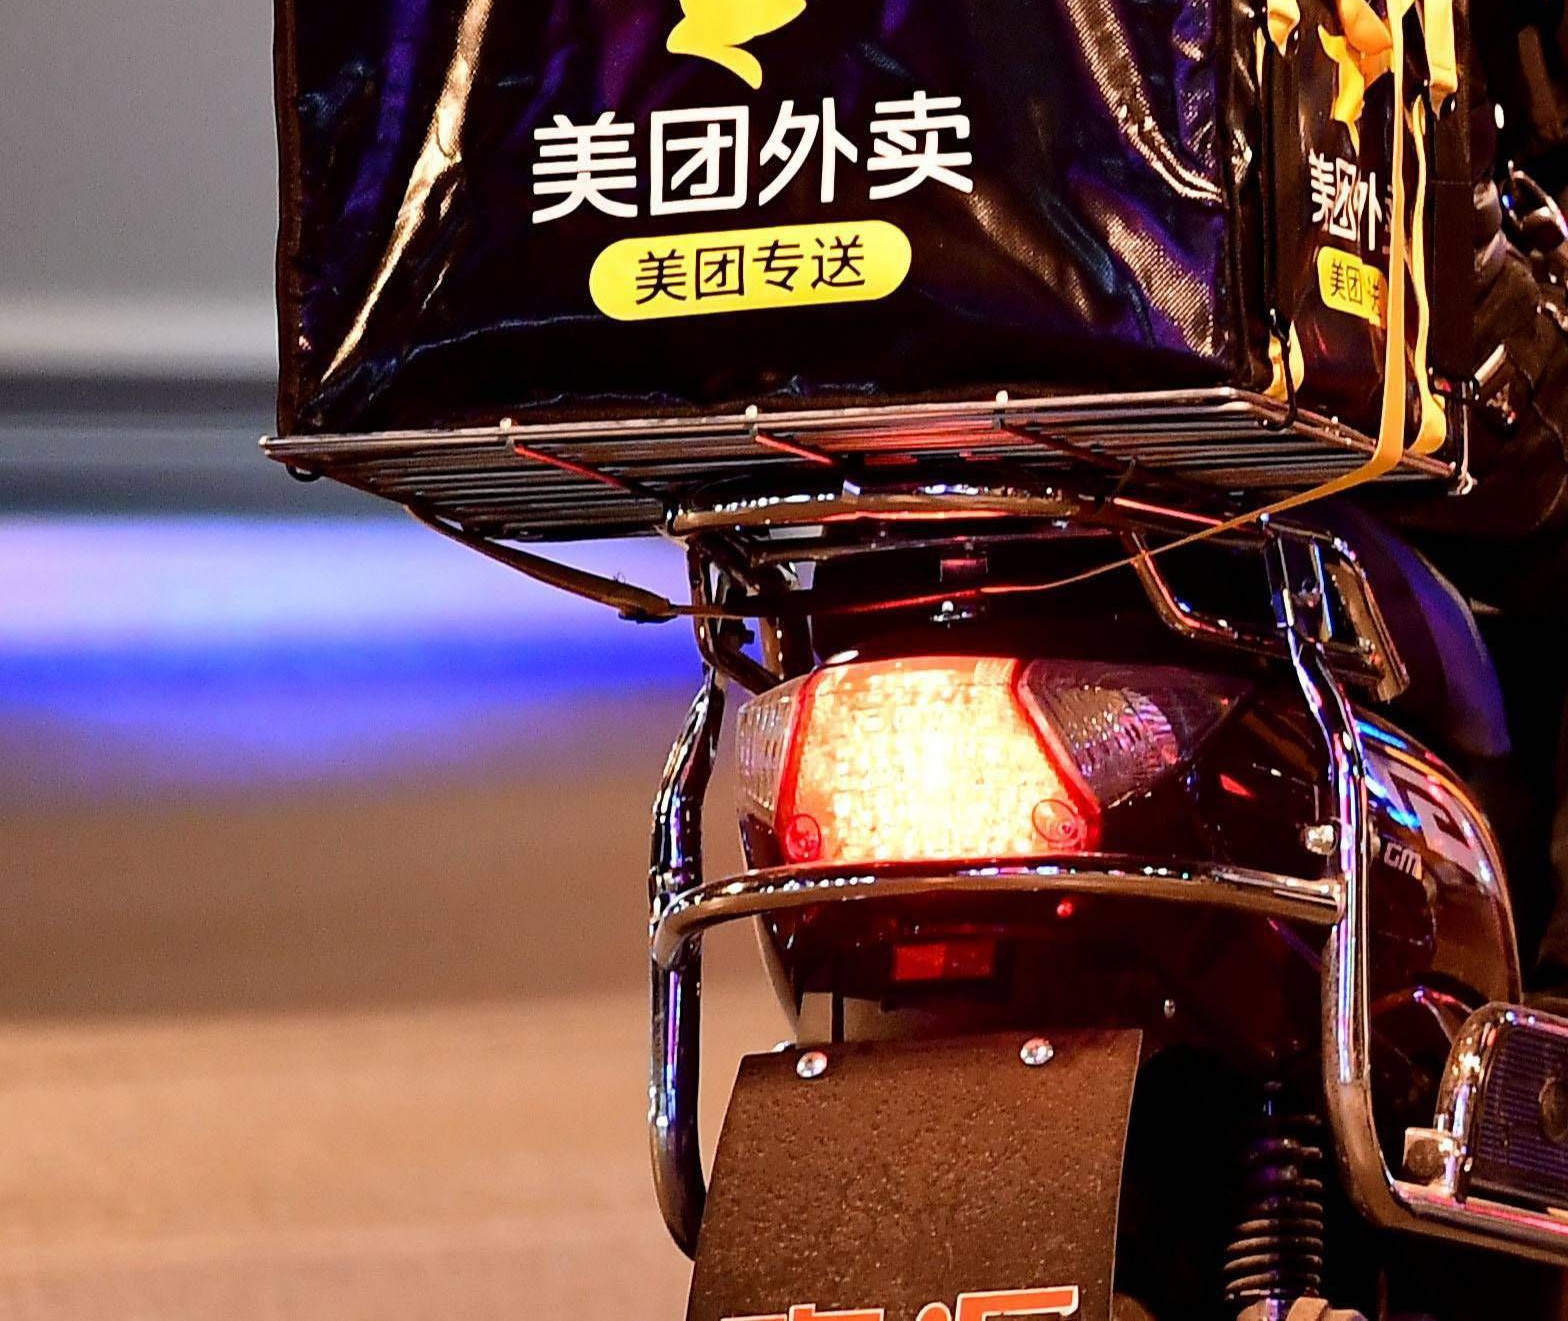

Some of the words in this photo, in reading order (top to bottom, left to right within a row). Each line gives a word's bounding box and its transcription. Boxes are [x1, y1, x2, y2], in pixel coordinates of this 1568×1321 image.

[530, 90, 975, 225] 美团外卖
[1308, 148, 1393, 255] 美团外
[634, 231, 868, 306] 美团专送
